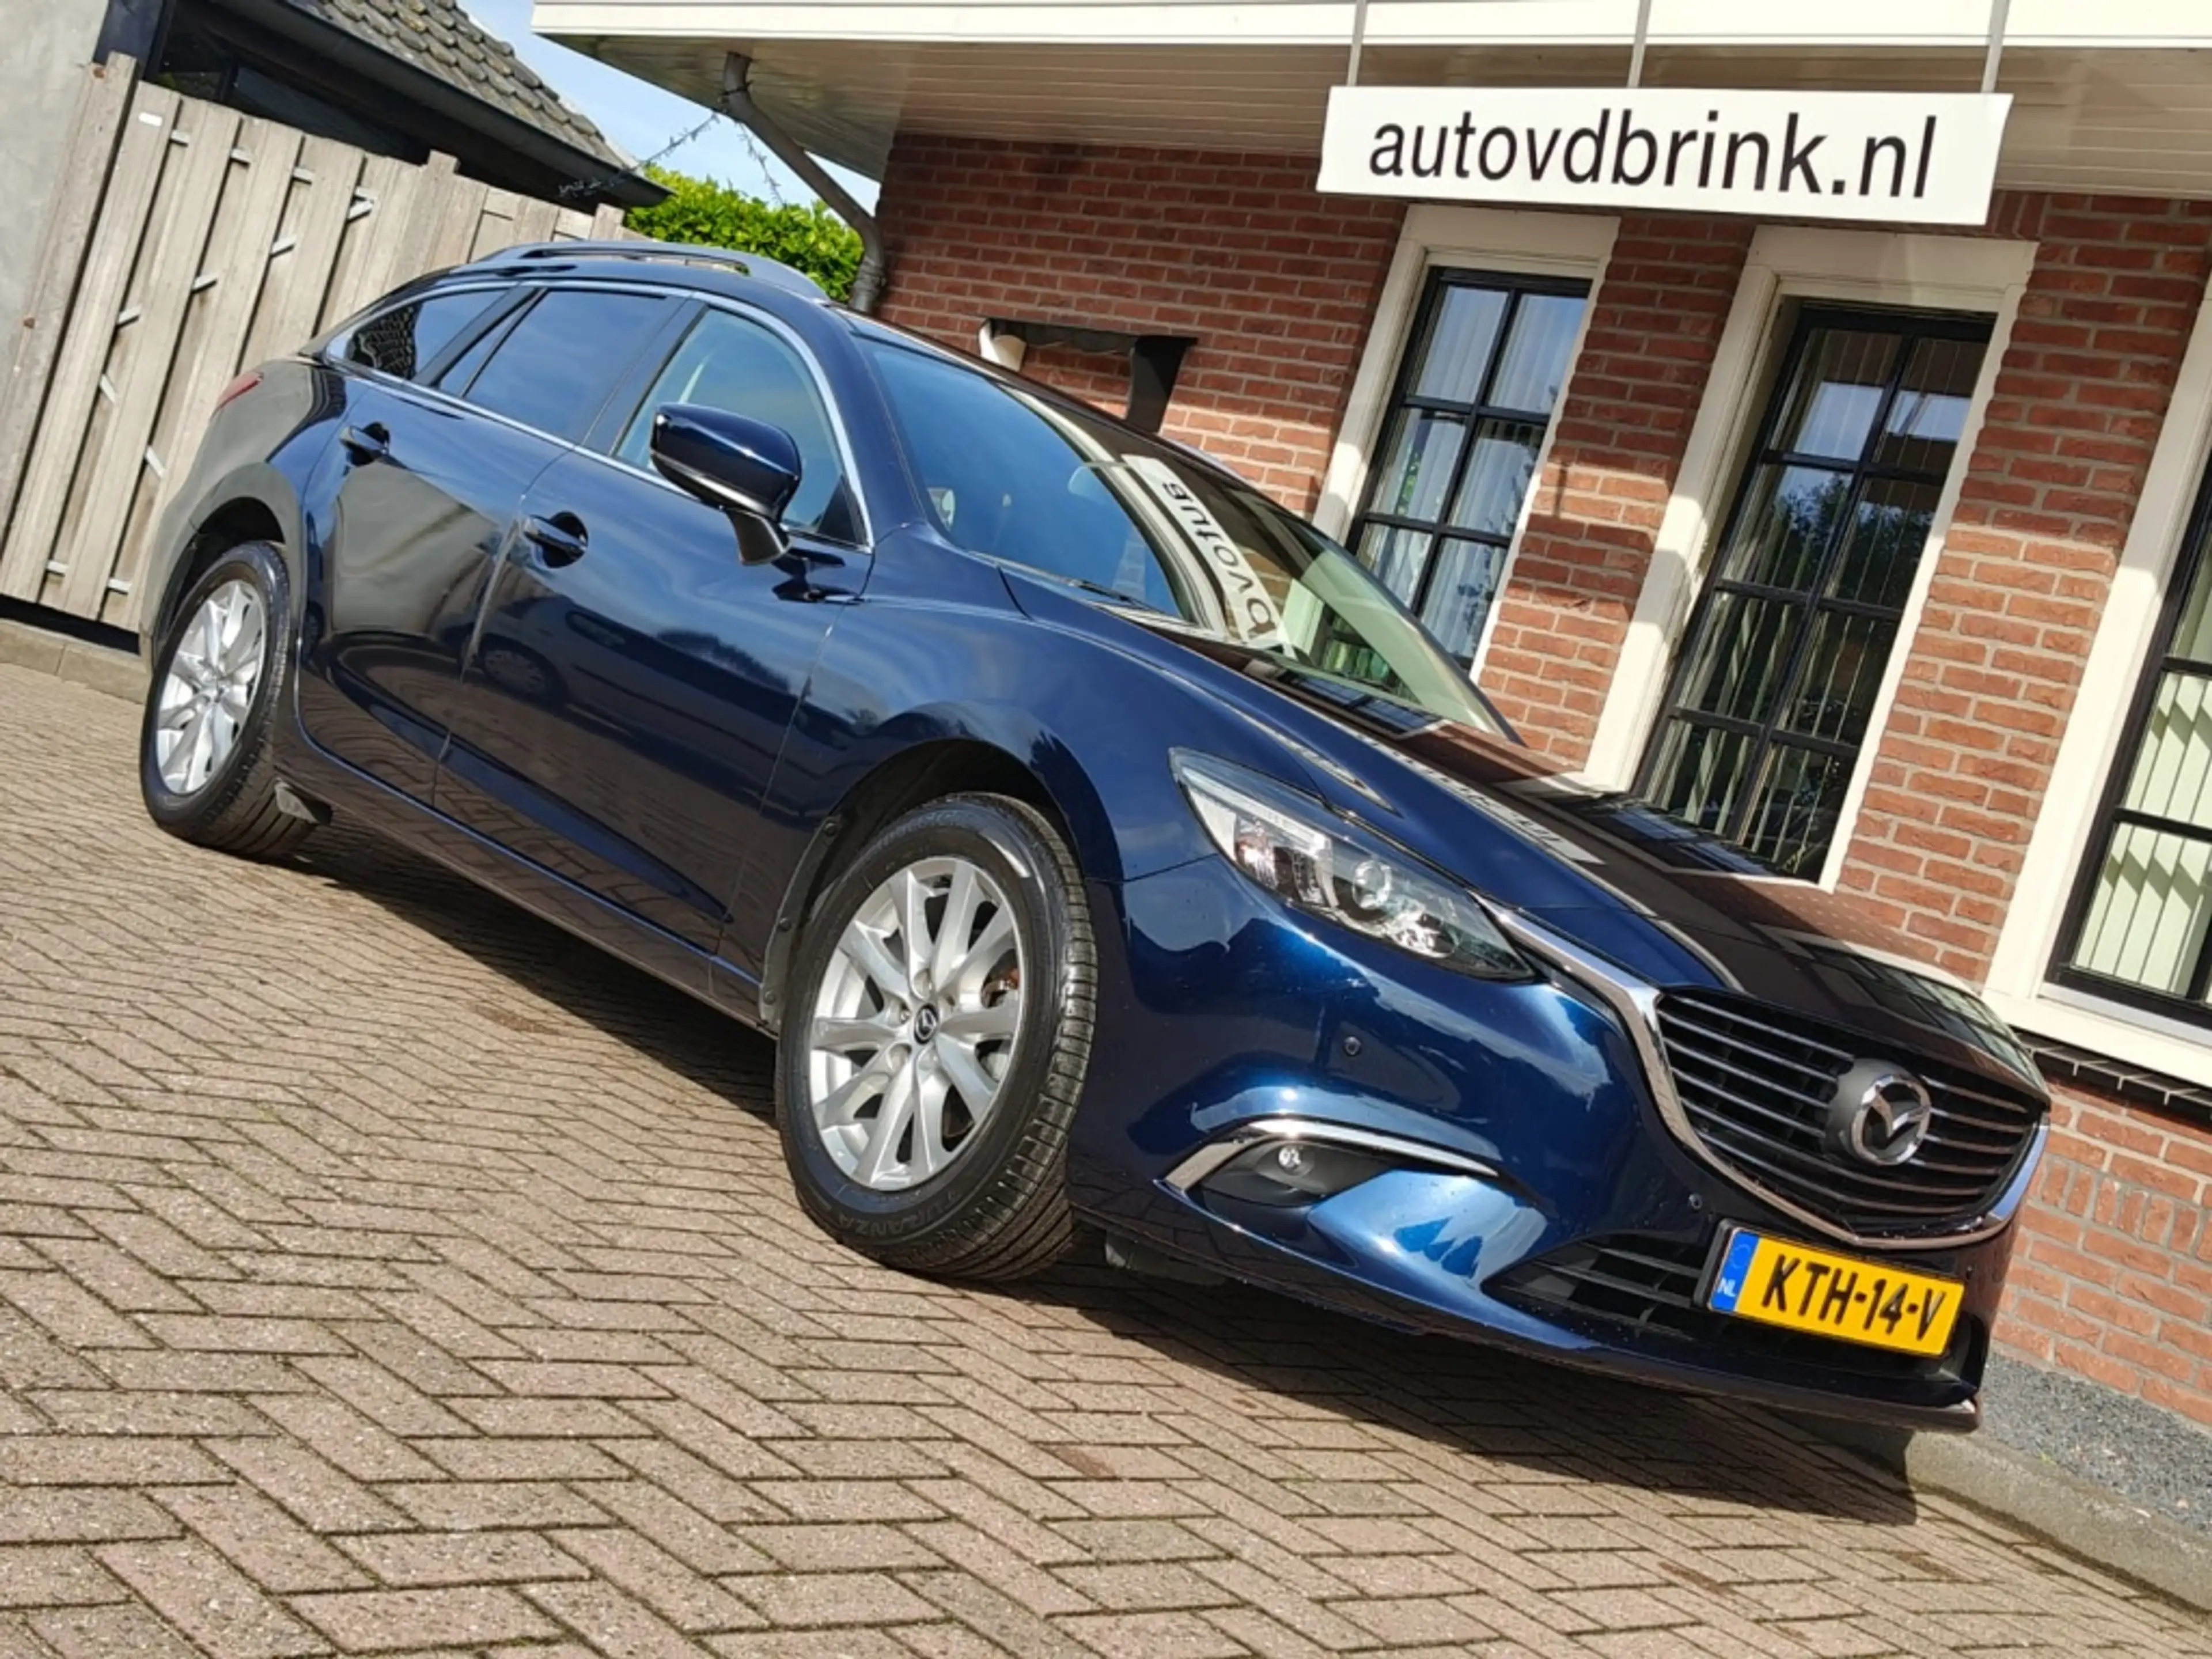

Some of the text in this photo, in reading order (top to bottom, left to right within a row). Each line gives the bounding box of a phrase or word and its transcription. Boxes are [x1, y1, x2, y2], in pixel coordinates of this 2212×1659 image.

[1369, 108, 1937, 199] autovdbrink.nl
[1717, 1279, 1736, 1297] NL
[1762, 1254, 1945, 1340] KTH-14-V
